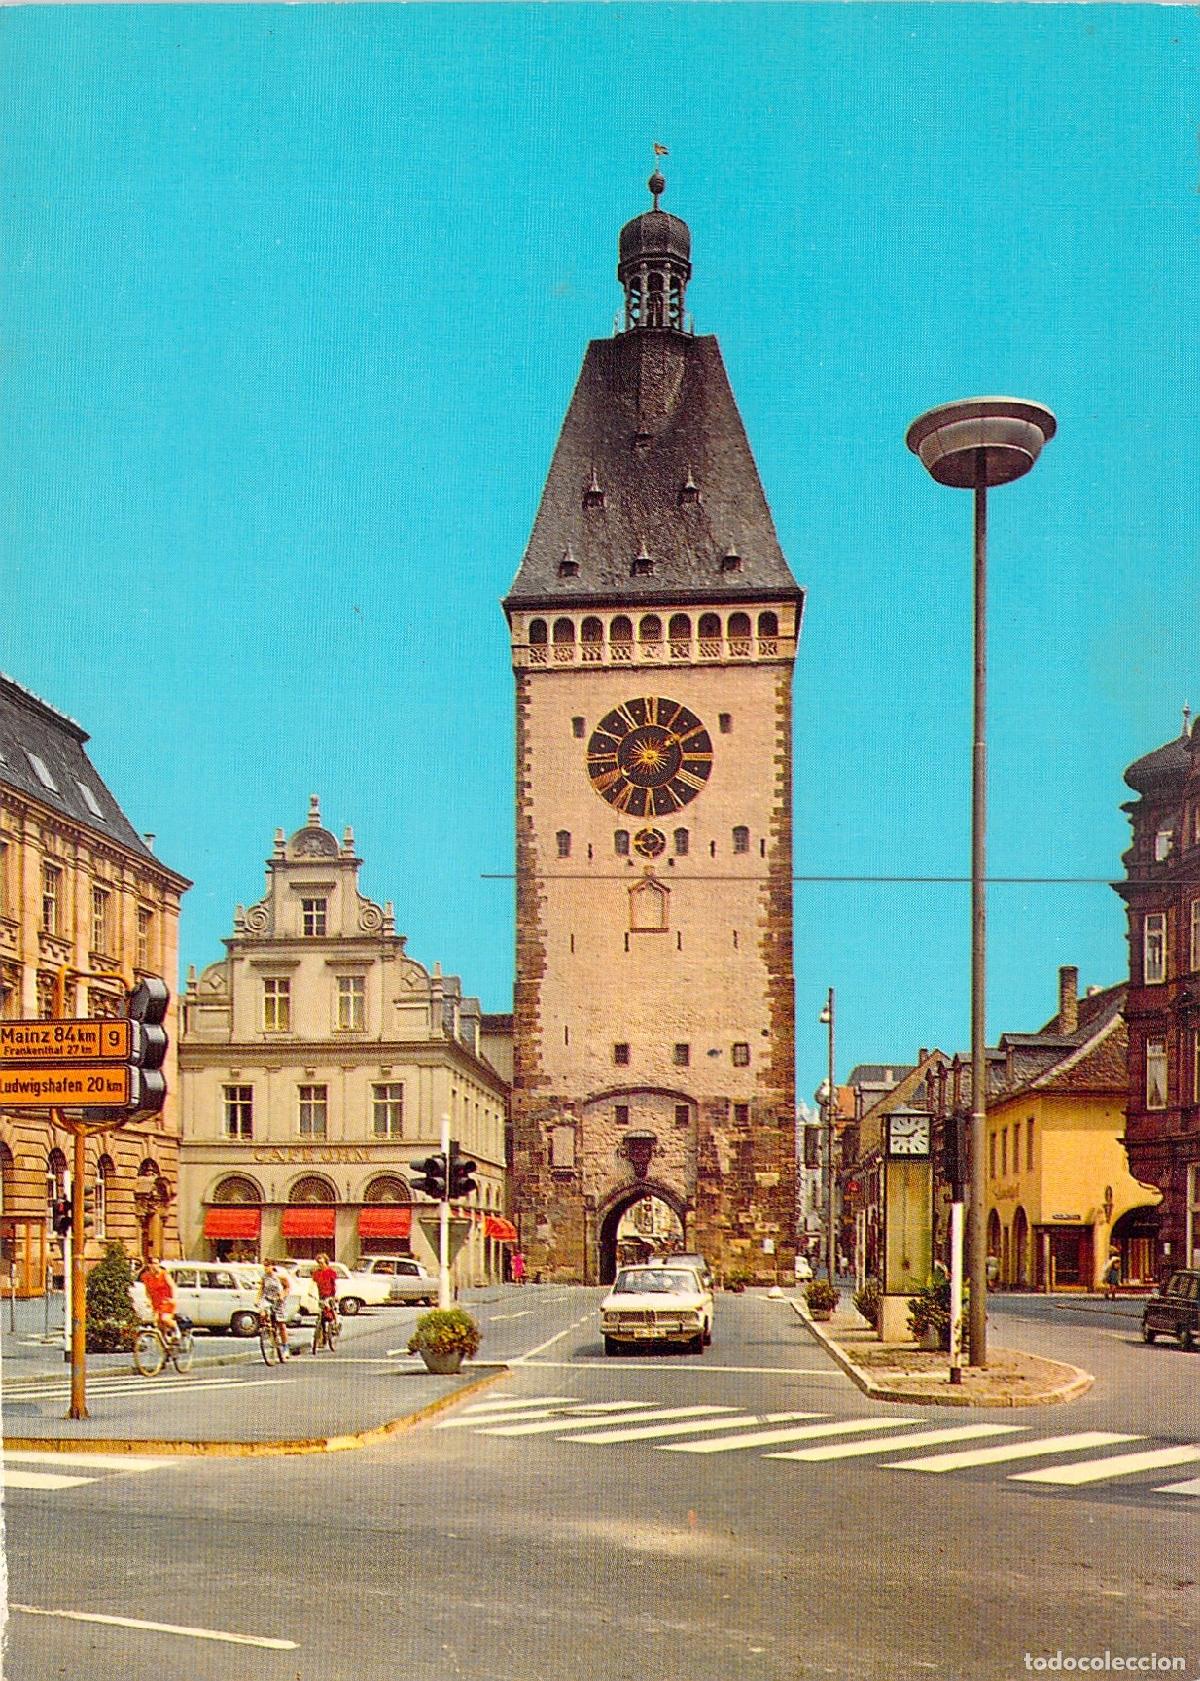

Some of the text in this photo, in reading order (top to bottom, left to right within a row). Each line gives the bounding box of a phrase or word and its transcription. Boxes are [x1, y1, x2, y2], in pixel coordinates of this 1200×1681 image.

[1, 1026, 96, 1043] Mainz 84 km
[109, 1031, 120, 1046] 9
[3, 1046, 63, 1056] Frankenthal
[66, 1044, 79, 1055] 27
[87, 1077, 104, 1092] 20
[106, 1079, 122, 1092] km
